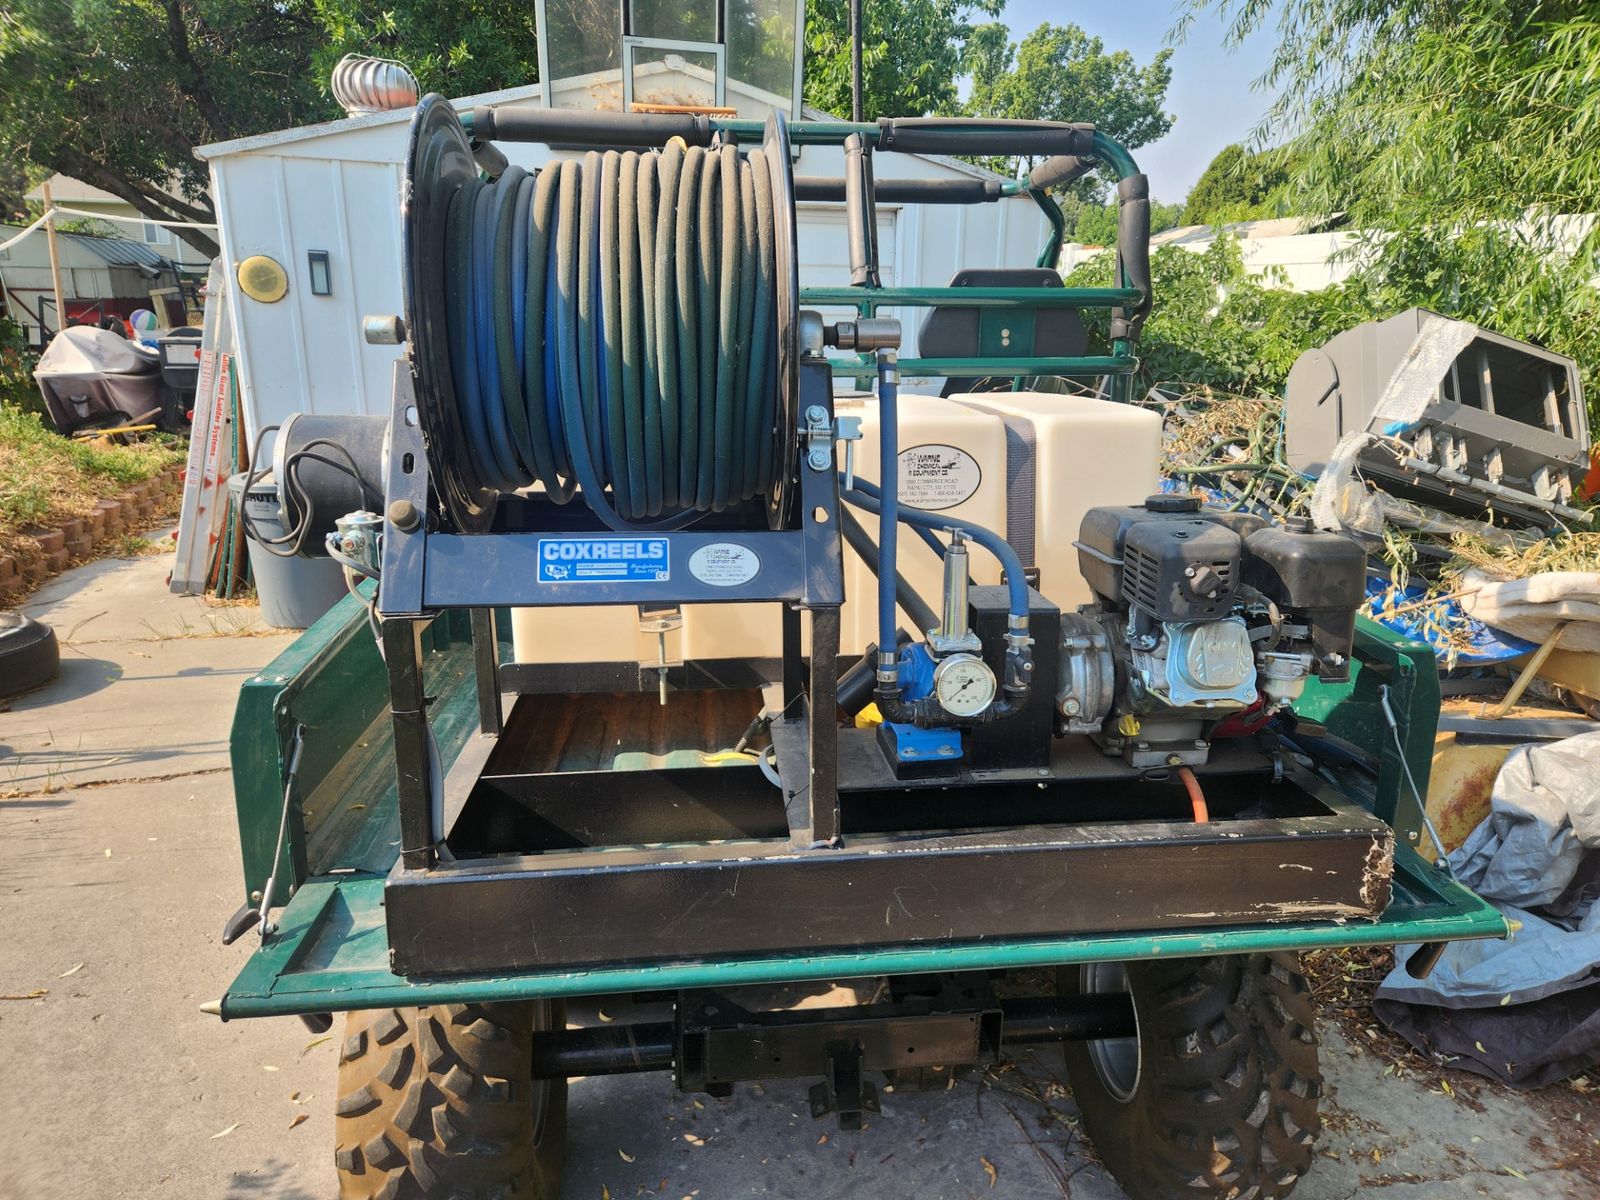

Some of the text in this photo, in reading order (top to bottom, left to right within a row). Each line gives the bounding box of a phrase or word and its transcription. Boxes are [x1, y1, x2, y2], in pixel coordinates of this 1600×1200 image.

[210, 354, 229, 456] Little Giant Ladder Systems
[917, 454, 941, 463] WARNE
[544, 542, 664, 560] COXREELS
